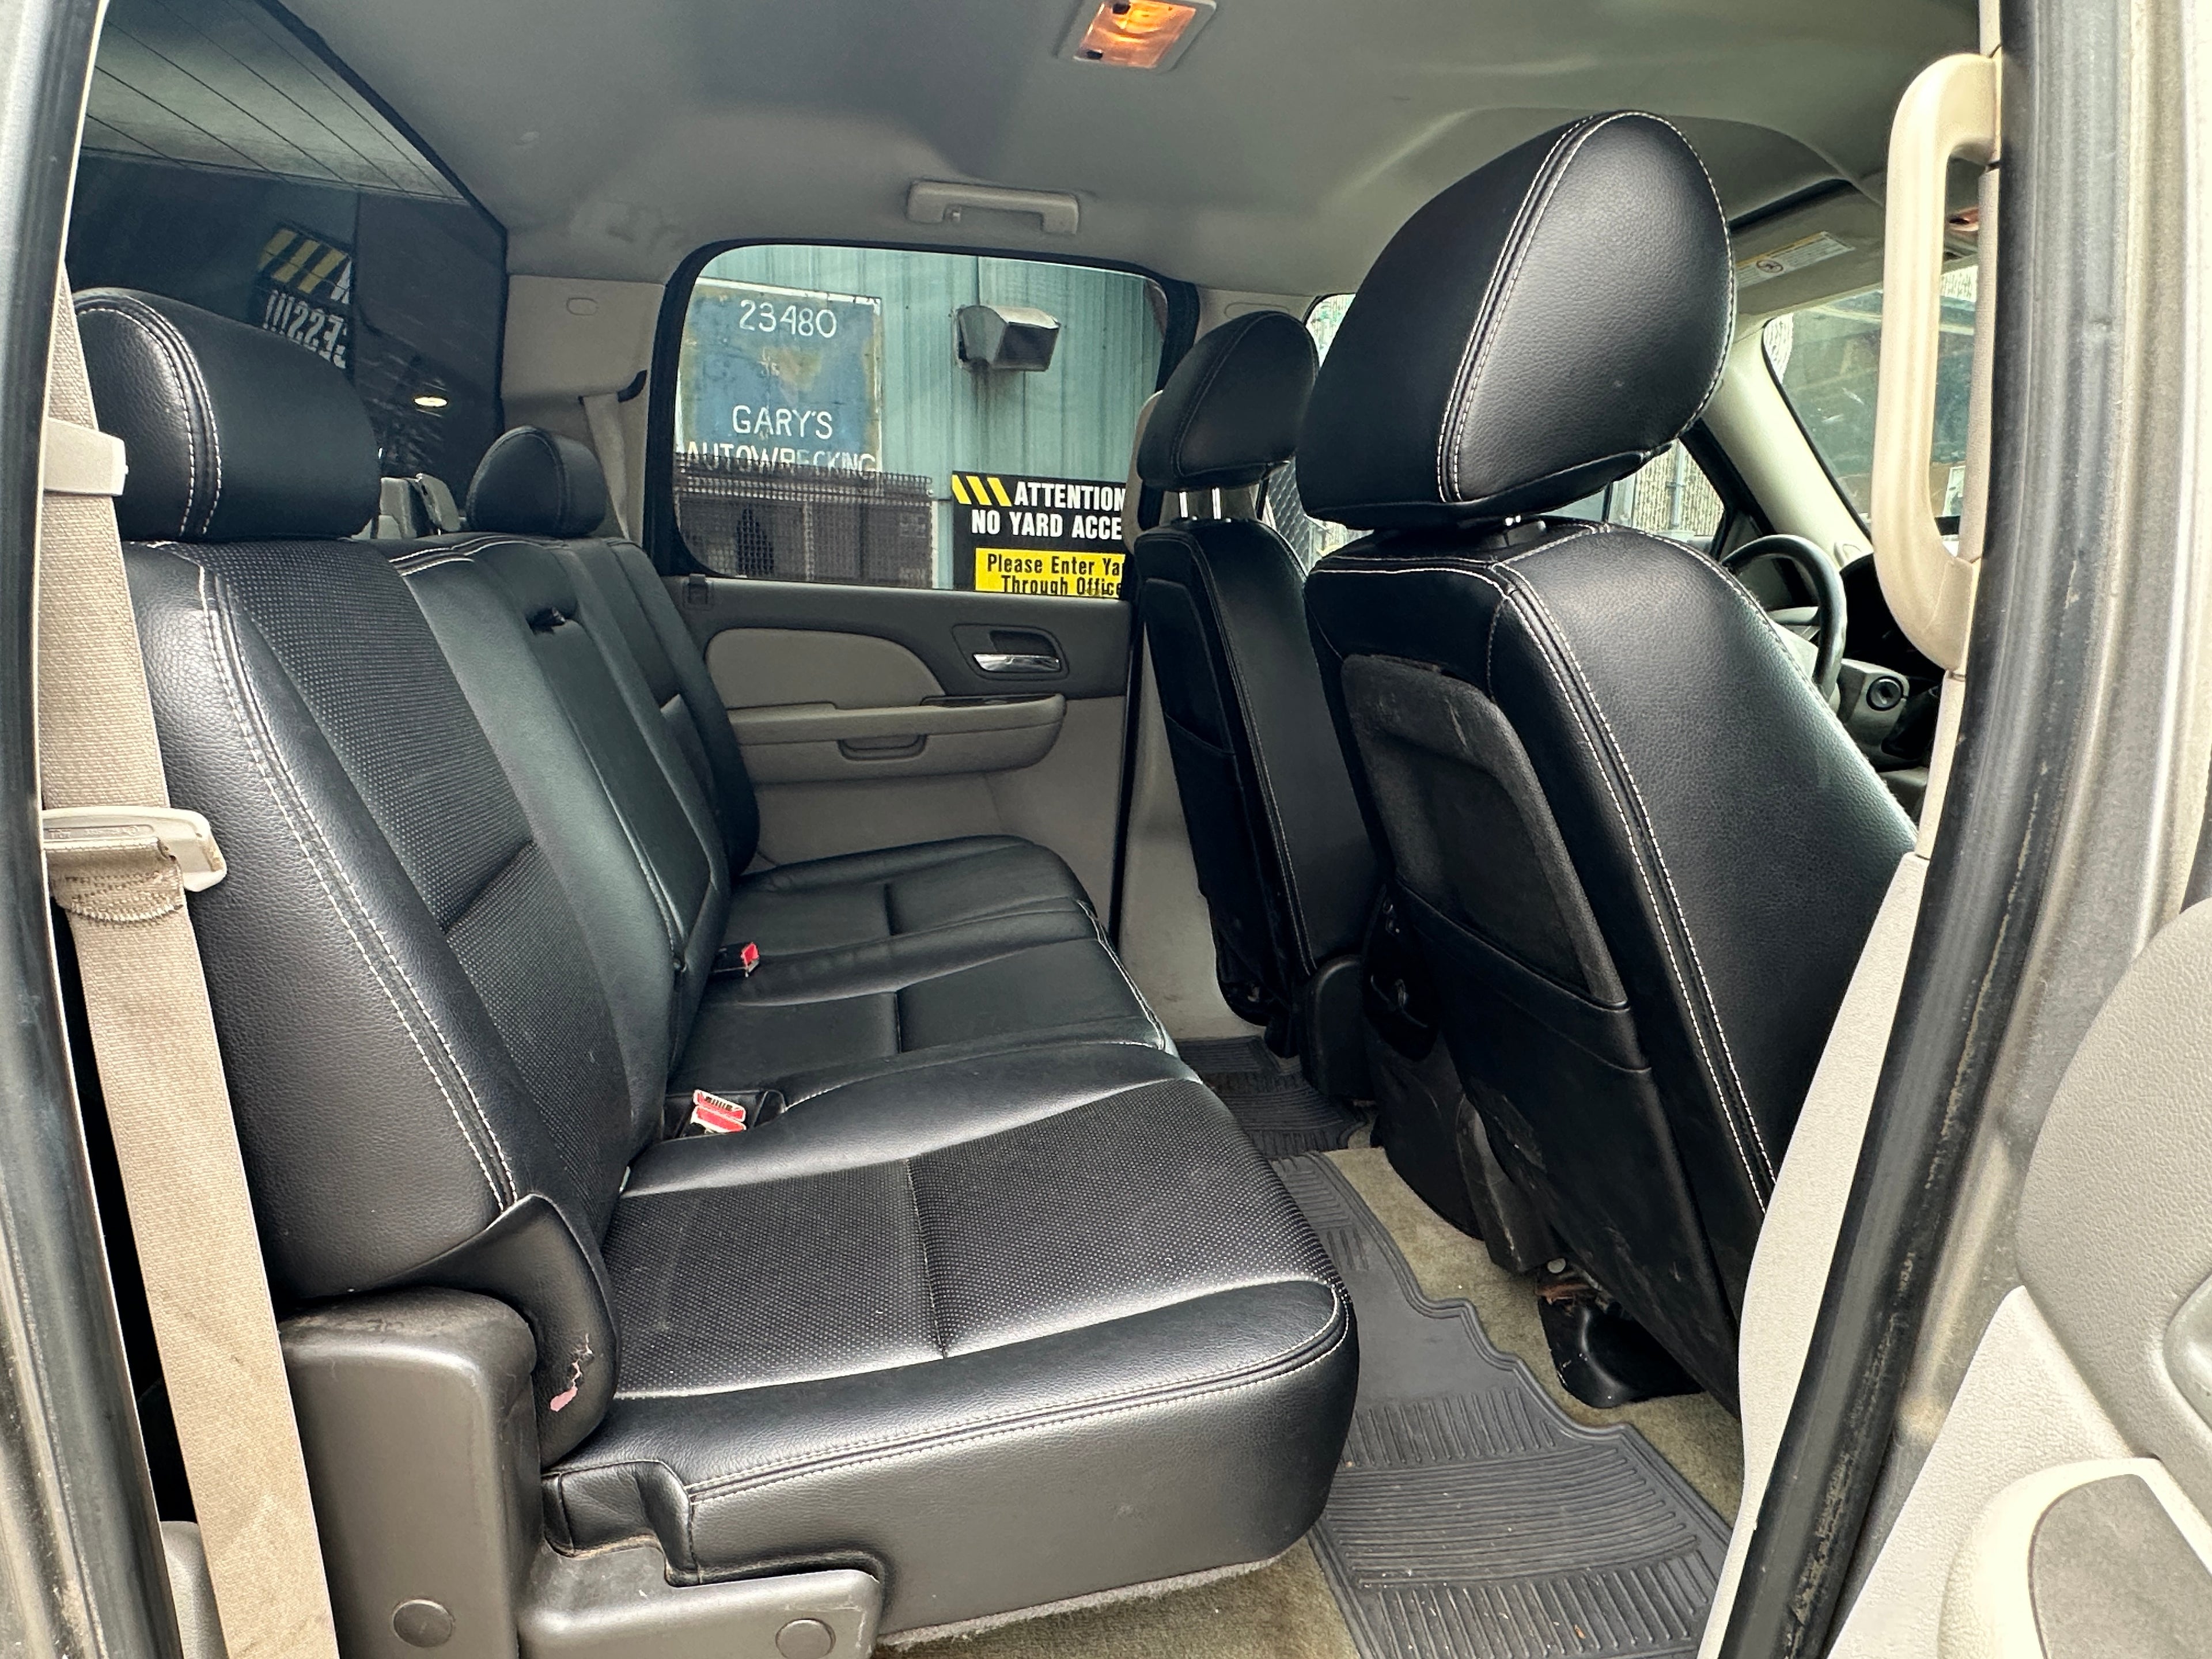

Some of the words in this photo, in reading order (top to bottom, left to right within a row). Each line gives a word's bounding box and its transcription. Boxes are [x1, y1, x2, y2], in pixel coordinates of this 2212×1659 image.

[739, 300, 838, 338] 23480
[732, 405, 832, 440] GARY'S
[686, 441, 876, 479] AUTOWRECKING
[1014, 481, 1126, 512] ATTENTION
[971, 509, 1001, 535] NO
[1009, 512, 1063, 537] YARD
[987, 554, 1043, 574] Please
[1051, 555, 1095, 575] Enter
[1103, 558, 1124, 576] Ya
[1001, 575, 1067, 596] Through
